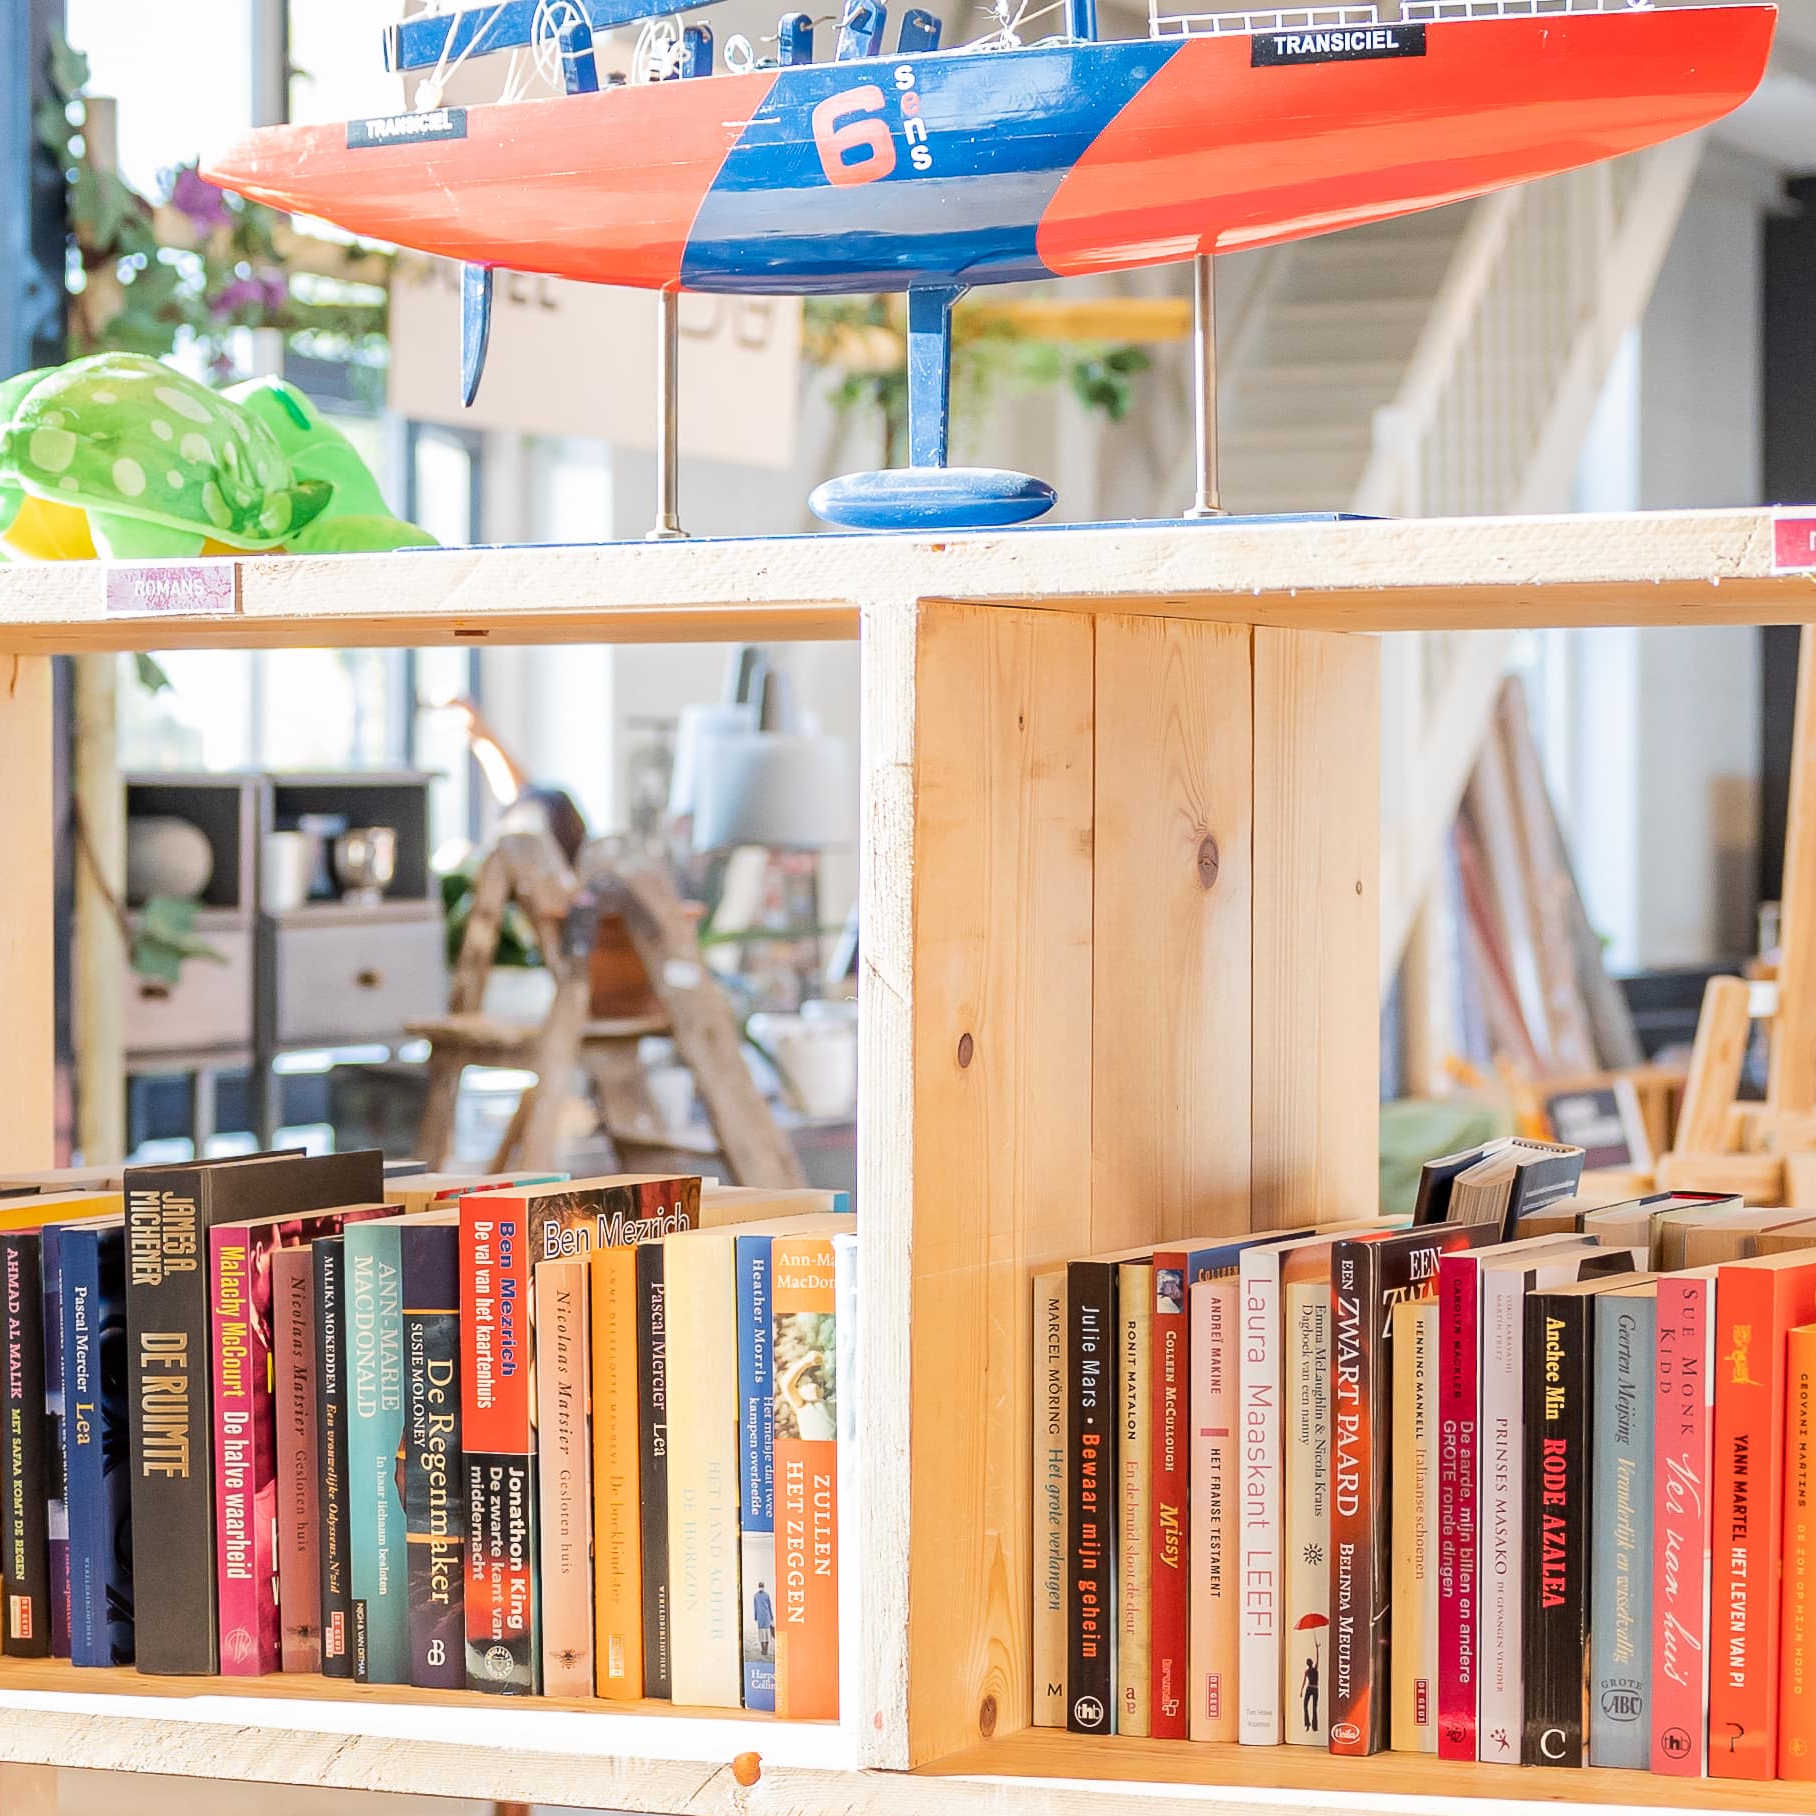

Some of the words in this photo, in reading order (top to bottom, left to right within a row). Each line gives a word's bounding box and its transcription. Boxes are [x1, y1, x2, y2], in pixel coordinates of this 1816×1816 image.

[1272, 28, 1399, 55] TRANSICIEL
[811, 84, 897, 188] 6
[134, 577, 205, 599] ROMANS
[130, 1191, 162, 1285] MICHENER
[162, 1191, 196, 1254] JAMES
[475, 1221, 492, 1241] De
[500, 1222, 515, 1269] Ben
[163, 1259, 197, 1276] A.
[215, 1247, 245, 1315] Malachy
[476, 1245, 493, 1265] val
[476, 1269, 492, 1294] van
[1341, 1260, 1353, 1290] EEN
[476, 1298, 494, 1322] het
[501, 1279, 516, 1376] Mezrich
[1081, 1306, 1101, 1352] Julie
[1247, 1278, 1273, 1364] Laura
[140, 1332, 188, 1368] DE
[221, 1322, 247, 1397] McCourt
[411, 1323, 423, 1366] SUSIE
[477, 1325, 495, 1408] kaartenhuis
[1337, 1297, 1360, 1405] ZWART
[1544, 1317, 1564, 1381] Anchee
[412, 1369, 425, 1447] MOLONEY
[427, 1359, 453, 1404] De
[1081, 1360, 1101, 1407] Mars
[1544, 1387, 1565, 1420] Min
[142, 1375, 189, 1479] RUIMTE
[223, 1411, 247, 1434] De
[224, 1440, 250, 1488] halve
[1082, 1434, 1102, 1512] Bewaar
[1247, 1385, 1273, 1529] Maaskant
[1337, 1413, 1359, 1516] PAARD
[1542, 1438, 1566, 1504] RODE
[1733, 1435, 1749, 1477] YANN
[421, 1414, 455, 1604] Regenmaker
[787, 1461, 803, 1513] HET
[1732, 1481, 1748, 1541] MARTEL
[226, 1494, 252, 1579] waarheid
[814, 1474, 831, 1577] ZULLEN
[1078, 1524, 1101, 1569] mijn
[788, 1520, 805, 1624] ZEGGEN
[1339, 1543, 1354, 1609] BELINDA
[1542, 1514, 1566, 1608] AZALEA
[1731, 1549, 1748, 1578] HET
[1077, 1581, 1102, 1658] geheim
[1247, 1551, 1273, 1637] LEEF!
[1730, 1583, 1748, 1632] LEVEN
[1338, 1616, 1354, 1699] MEULDIJK
[1729, 1673, 1746, 1688] PI
[1730, 1637, 1747, 1667] VAN
